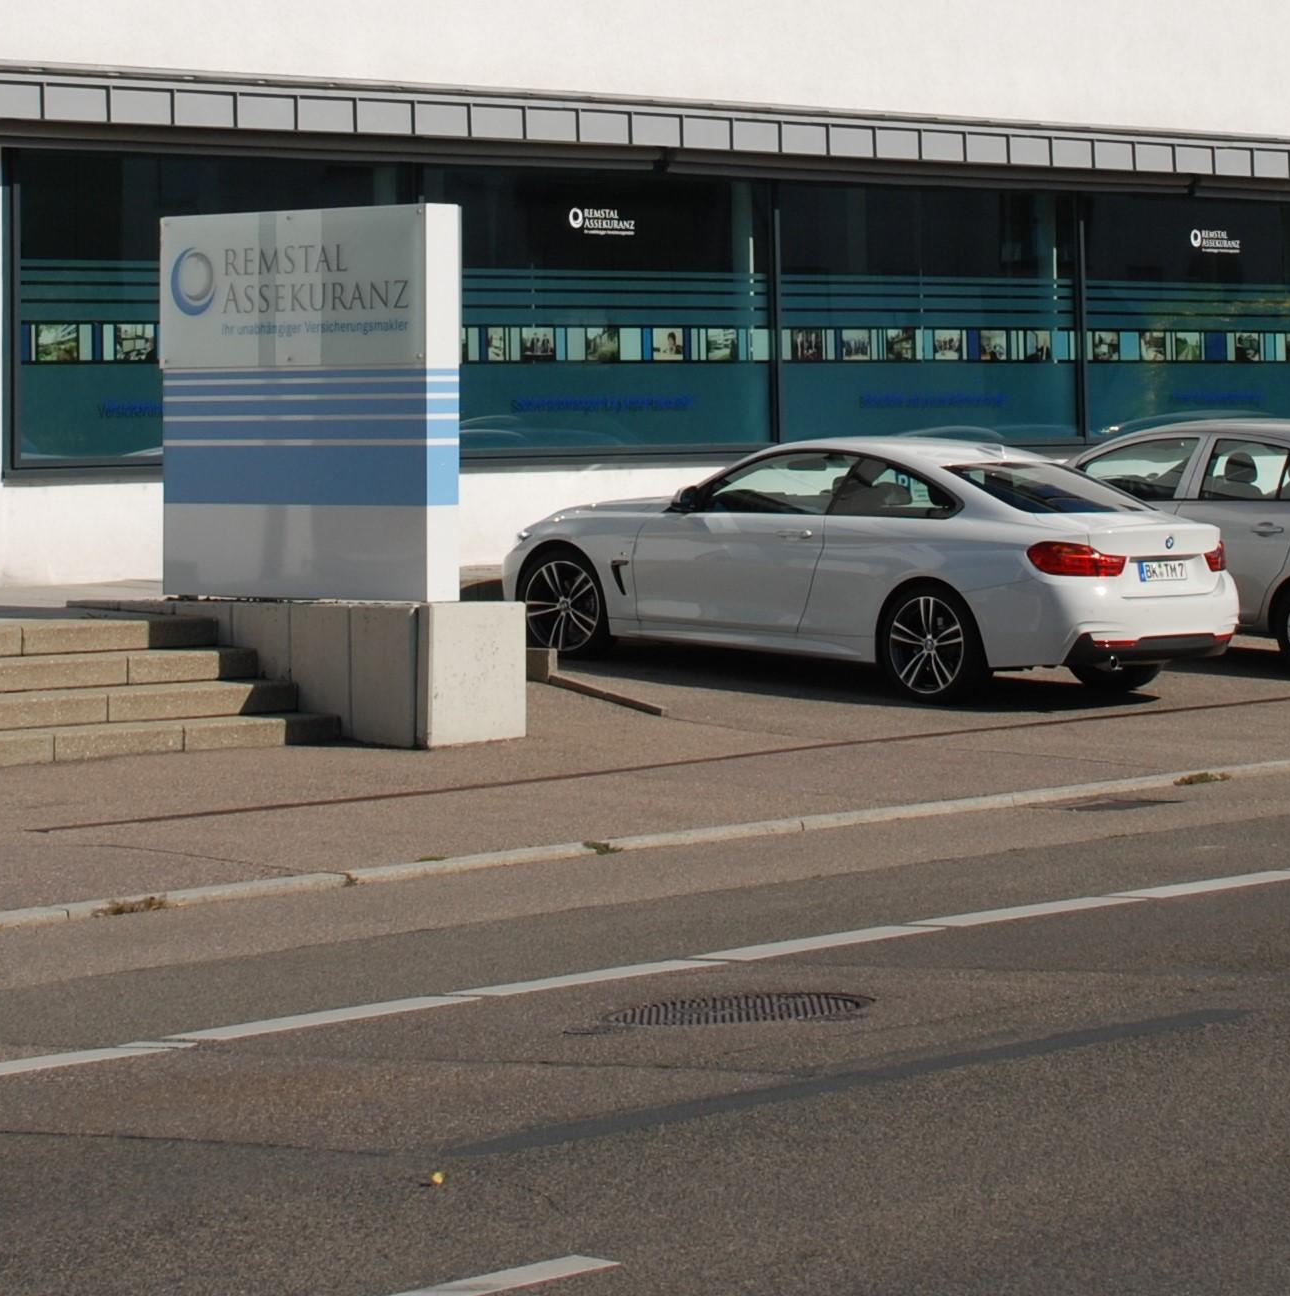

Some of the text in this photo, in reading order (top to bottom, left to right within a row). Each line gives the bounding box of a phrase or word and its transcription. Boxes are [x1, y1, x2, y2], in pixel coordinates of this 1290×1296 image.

[584, 208, 619, 219] REMSTAL
[583, 218, 635, 230] ASSEKURANZ
[223, 244, 349, 277] REMSTAL
[221, 280, 409, 314] ASSEKURANZ
[221, 318, 409, 338] Ihr unabhängiger Versicherungsmakler
[1144, 563, 1159, 579] BK
